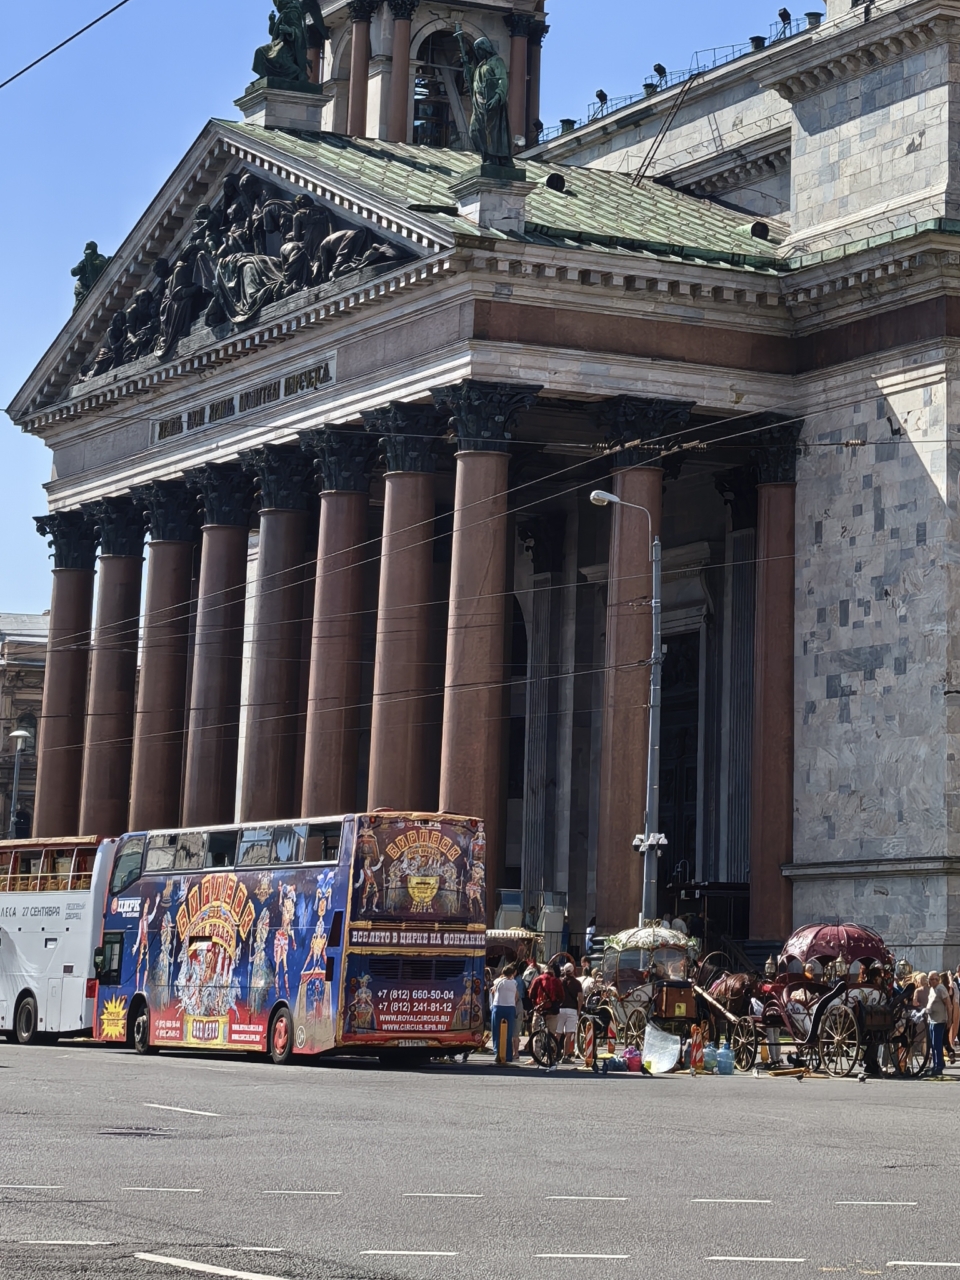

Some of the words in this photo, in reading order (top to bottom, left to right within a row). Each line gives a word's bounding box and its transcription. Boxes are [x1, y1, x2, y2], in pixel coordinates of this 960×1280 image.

[385, 830, 461, 860] БУРЛЕСК
[22, 906, 29, 917] 27
[30, 906, 60, 917] СЕНТЯБРЯ
[117, 900, 141, 912] ЦИРК
[177, 873, 254, 939] БУРЛЕСК
[368, 931, 390, 943] ЛЕТО
[392, 932, 398, 943] В
[400, 932, 428, 944] ЦИРКЕ
[430, 933, 441, 944] НА
[443, 933, 485, 945] ФОНТАНКЕ
[378, 990, 388, 999] +7
[389, 989, 410, 1000] (812)
[412, 990, 454, 999] 660-50-04
[378, 1002, 388, 1011] +7
[390, 1002, 410, 1013] (812)
[413, 1003, 452, 1012] 241-81-12
[380, 1014, 450, 1022] WWW.ROYALCIRCUS.RU
